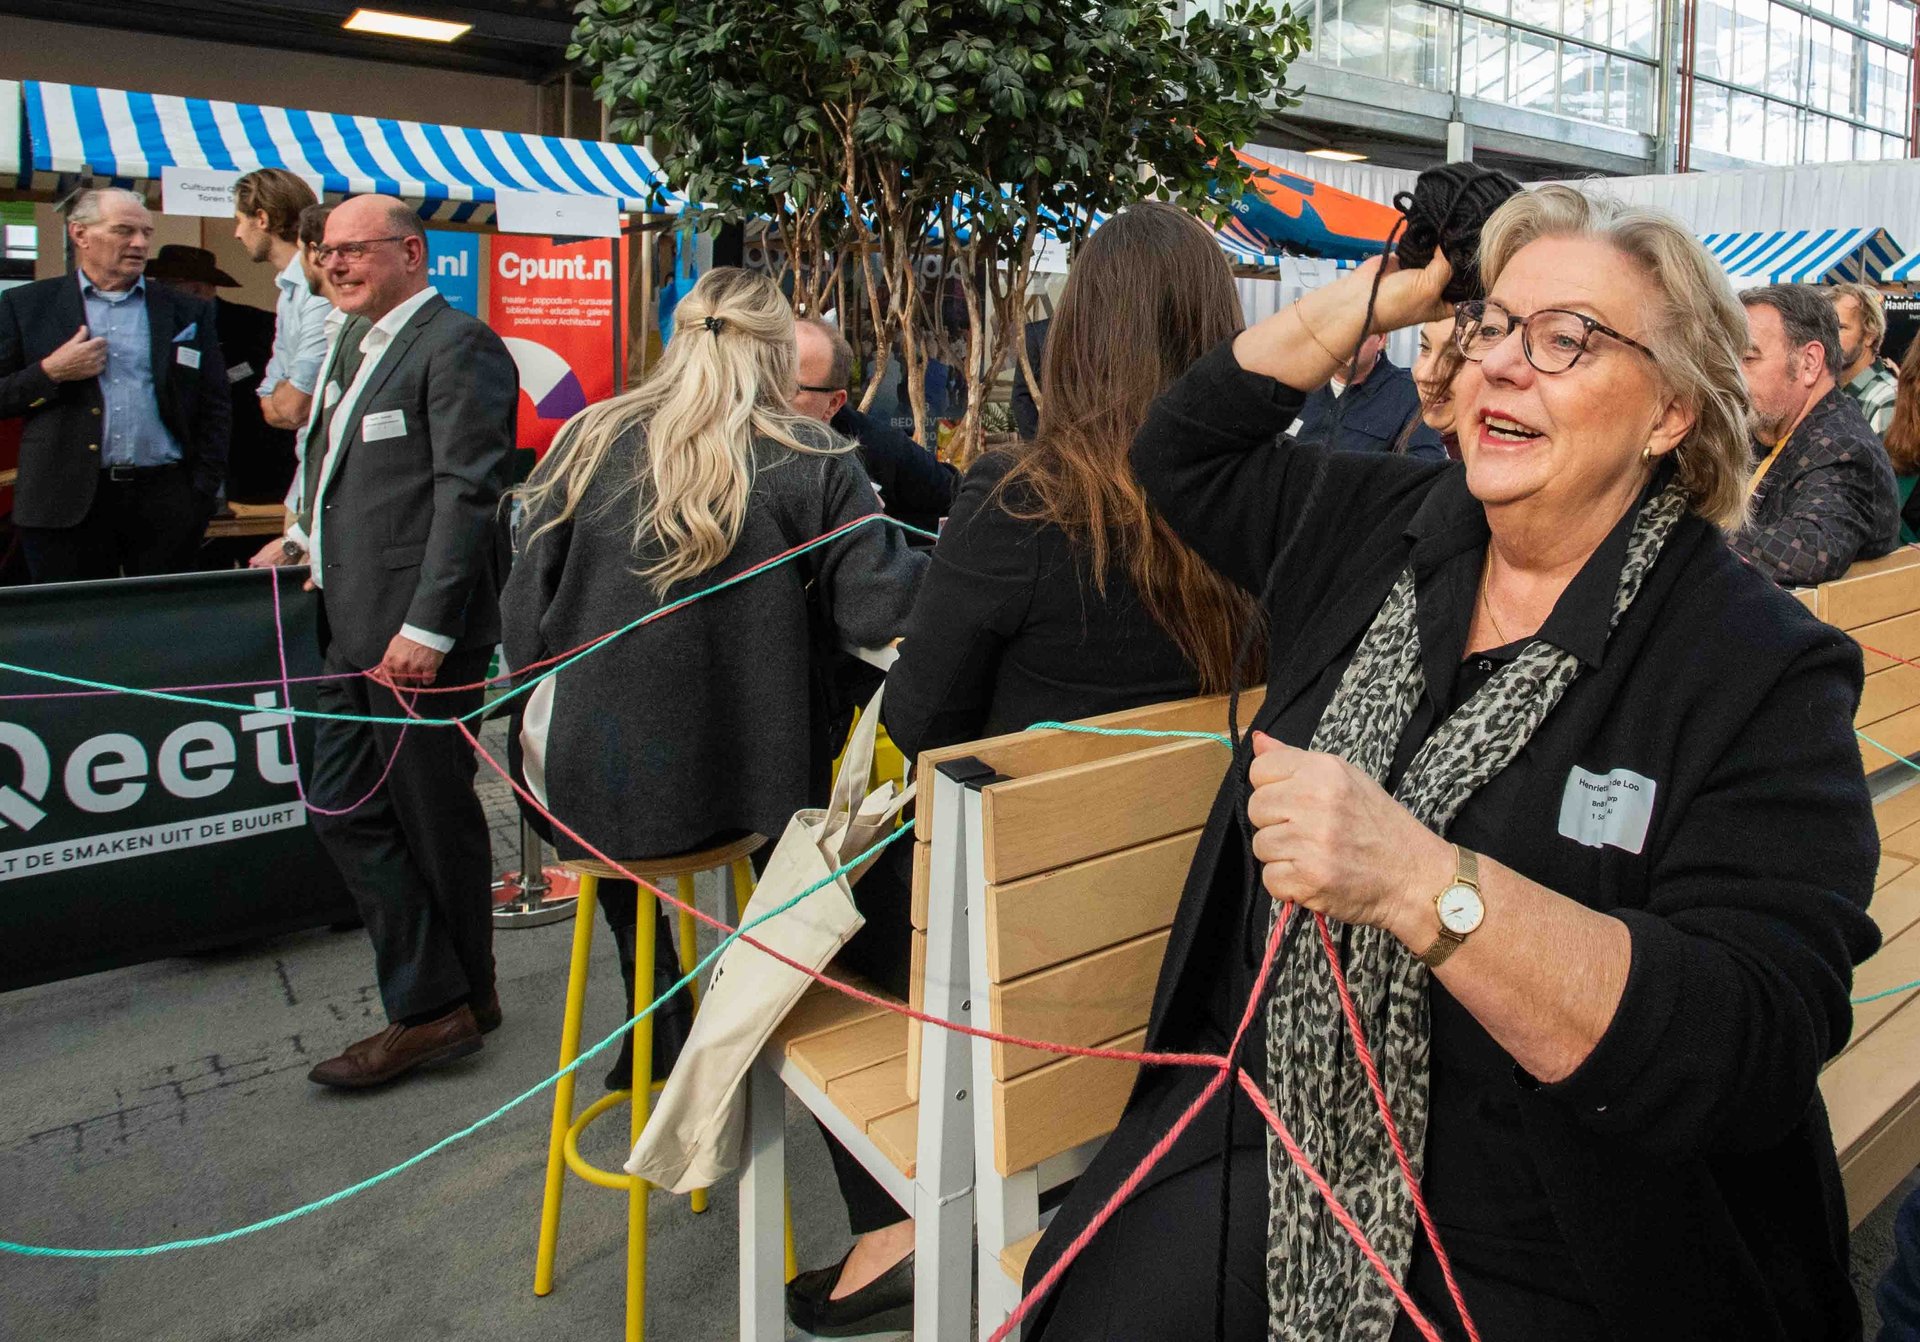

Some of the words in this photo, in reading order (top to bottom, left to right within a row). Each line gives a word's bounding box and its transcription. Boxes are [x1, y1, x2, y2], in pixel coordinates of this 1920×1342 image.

[498, 251, 612, 286] Cpunt.n
[501, 296, 526, 304] theater
[532, 297, 573, 306] poppodium
[506, 306, 543, 315] bibliotheek
[549, 308, 580, 316] educatie
[586, 308, 609, 317] galerie
[514, 317, 541, 326] podium
[542, 318, 557, 326] voor
[558, 318, 601, 326] Architectuur
[1623, 780, 1640, 792] Loo
[26, 852, 54, 869] DE
[62, 833, 153, 863] SMAKEN
[160, 827, 194, 845] UIT
[200, 821, 226, 838] DE
[232, 809, 295, 832] BUURT
